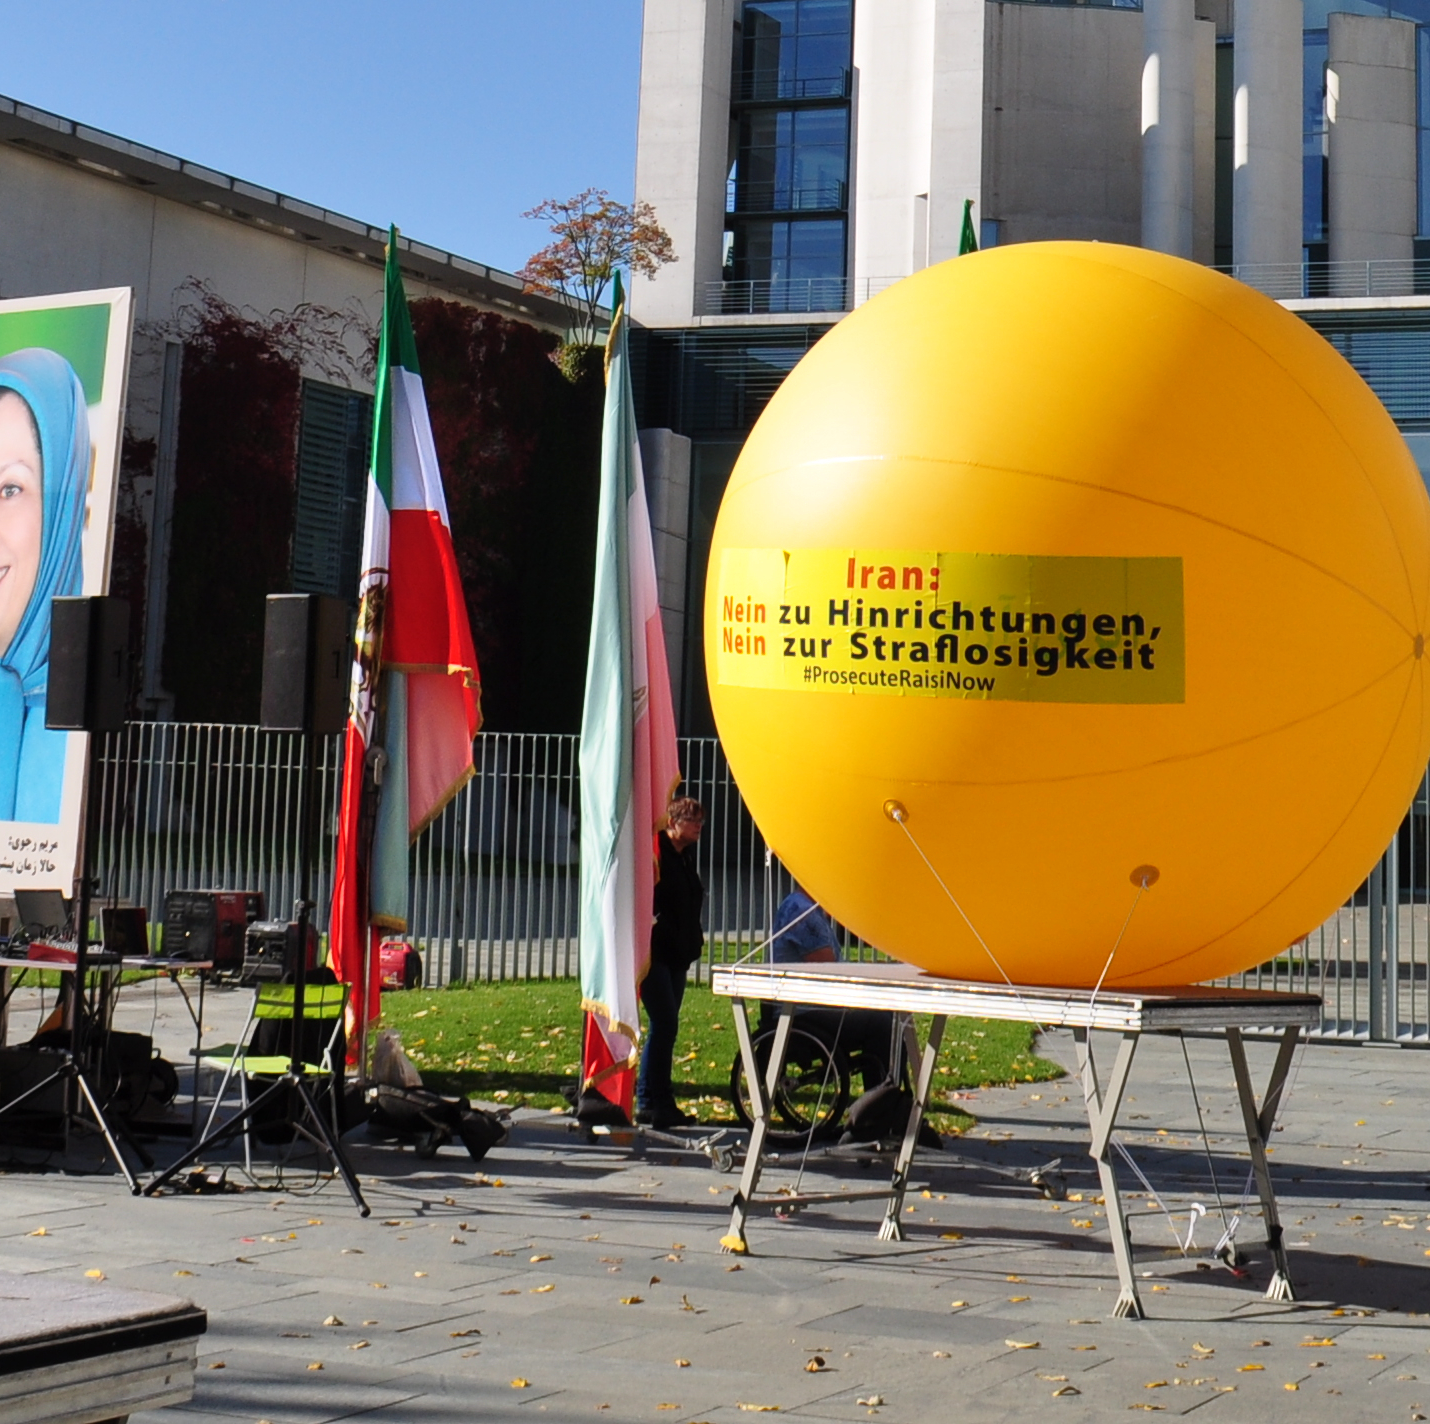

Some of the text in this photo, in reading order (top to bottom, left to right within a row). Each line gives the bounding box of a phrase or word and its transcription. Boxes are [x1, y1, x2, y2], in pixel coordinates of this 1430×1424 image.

[846, 556, 940, 591] Iran:
[723, 595, 1162, 641] Nein zu Hinrichtungen,
[723, 627, 1156, 675] Nein zur Straflosigkeit
[803, 665, 995, 692] #ProsecuteRaisiNow
